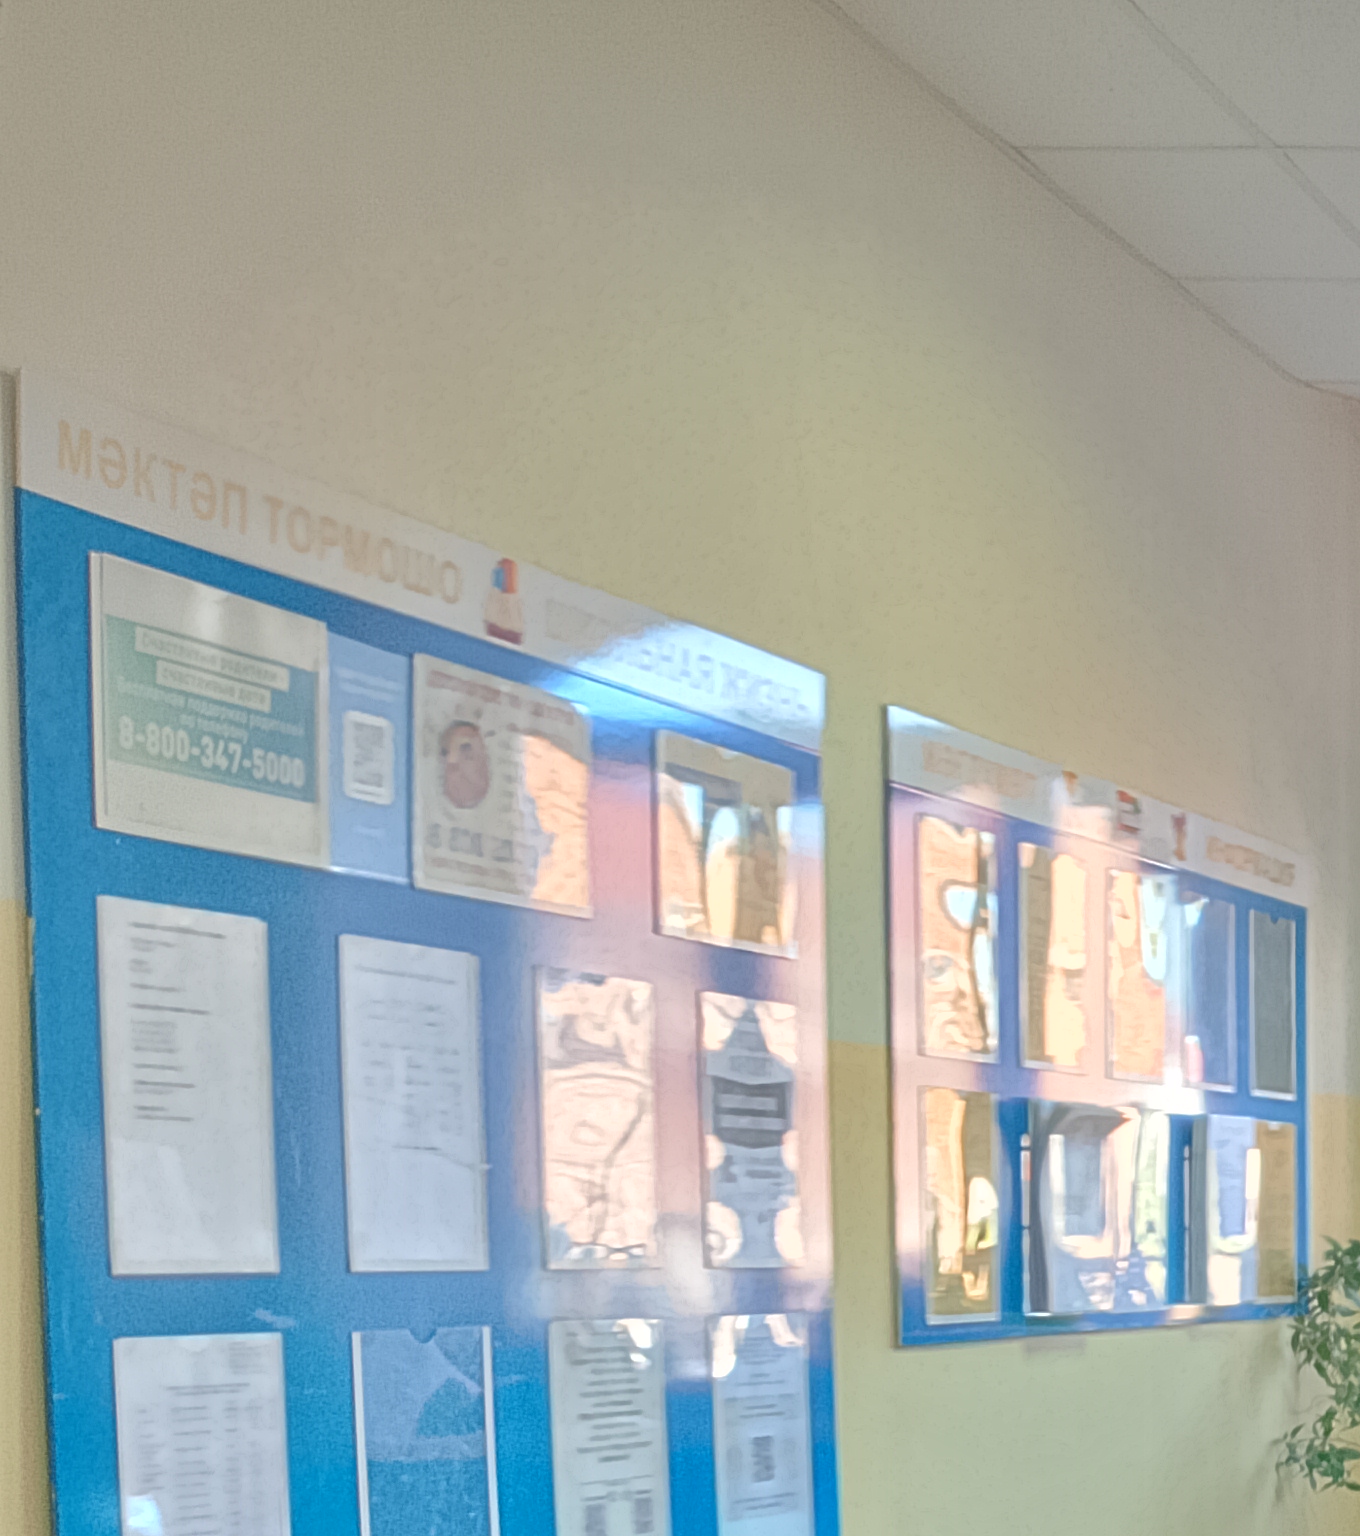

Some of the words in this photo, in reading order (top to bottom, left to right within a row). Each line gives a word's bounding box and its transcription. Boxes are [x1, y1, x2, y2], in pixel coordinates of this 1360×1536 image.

[57, 419, 247, 536] МӘКТӘП
[262, 494, 464, 606] ТОРМОШО
[119, 716, 305, 788] 8-800-347-5000
